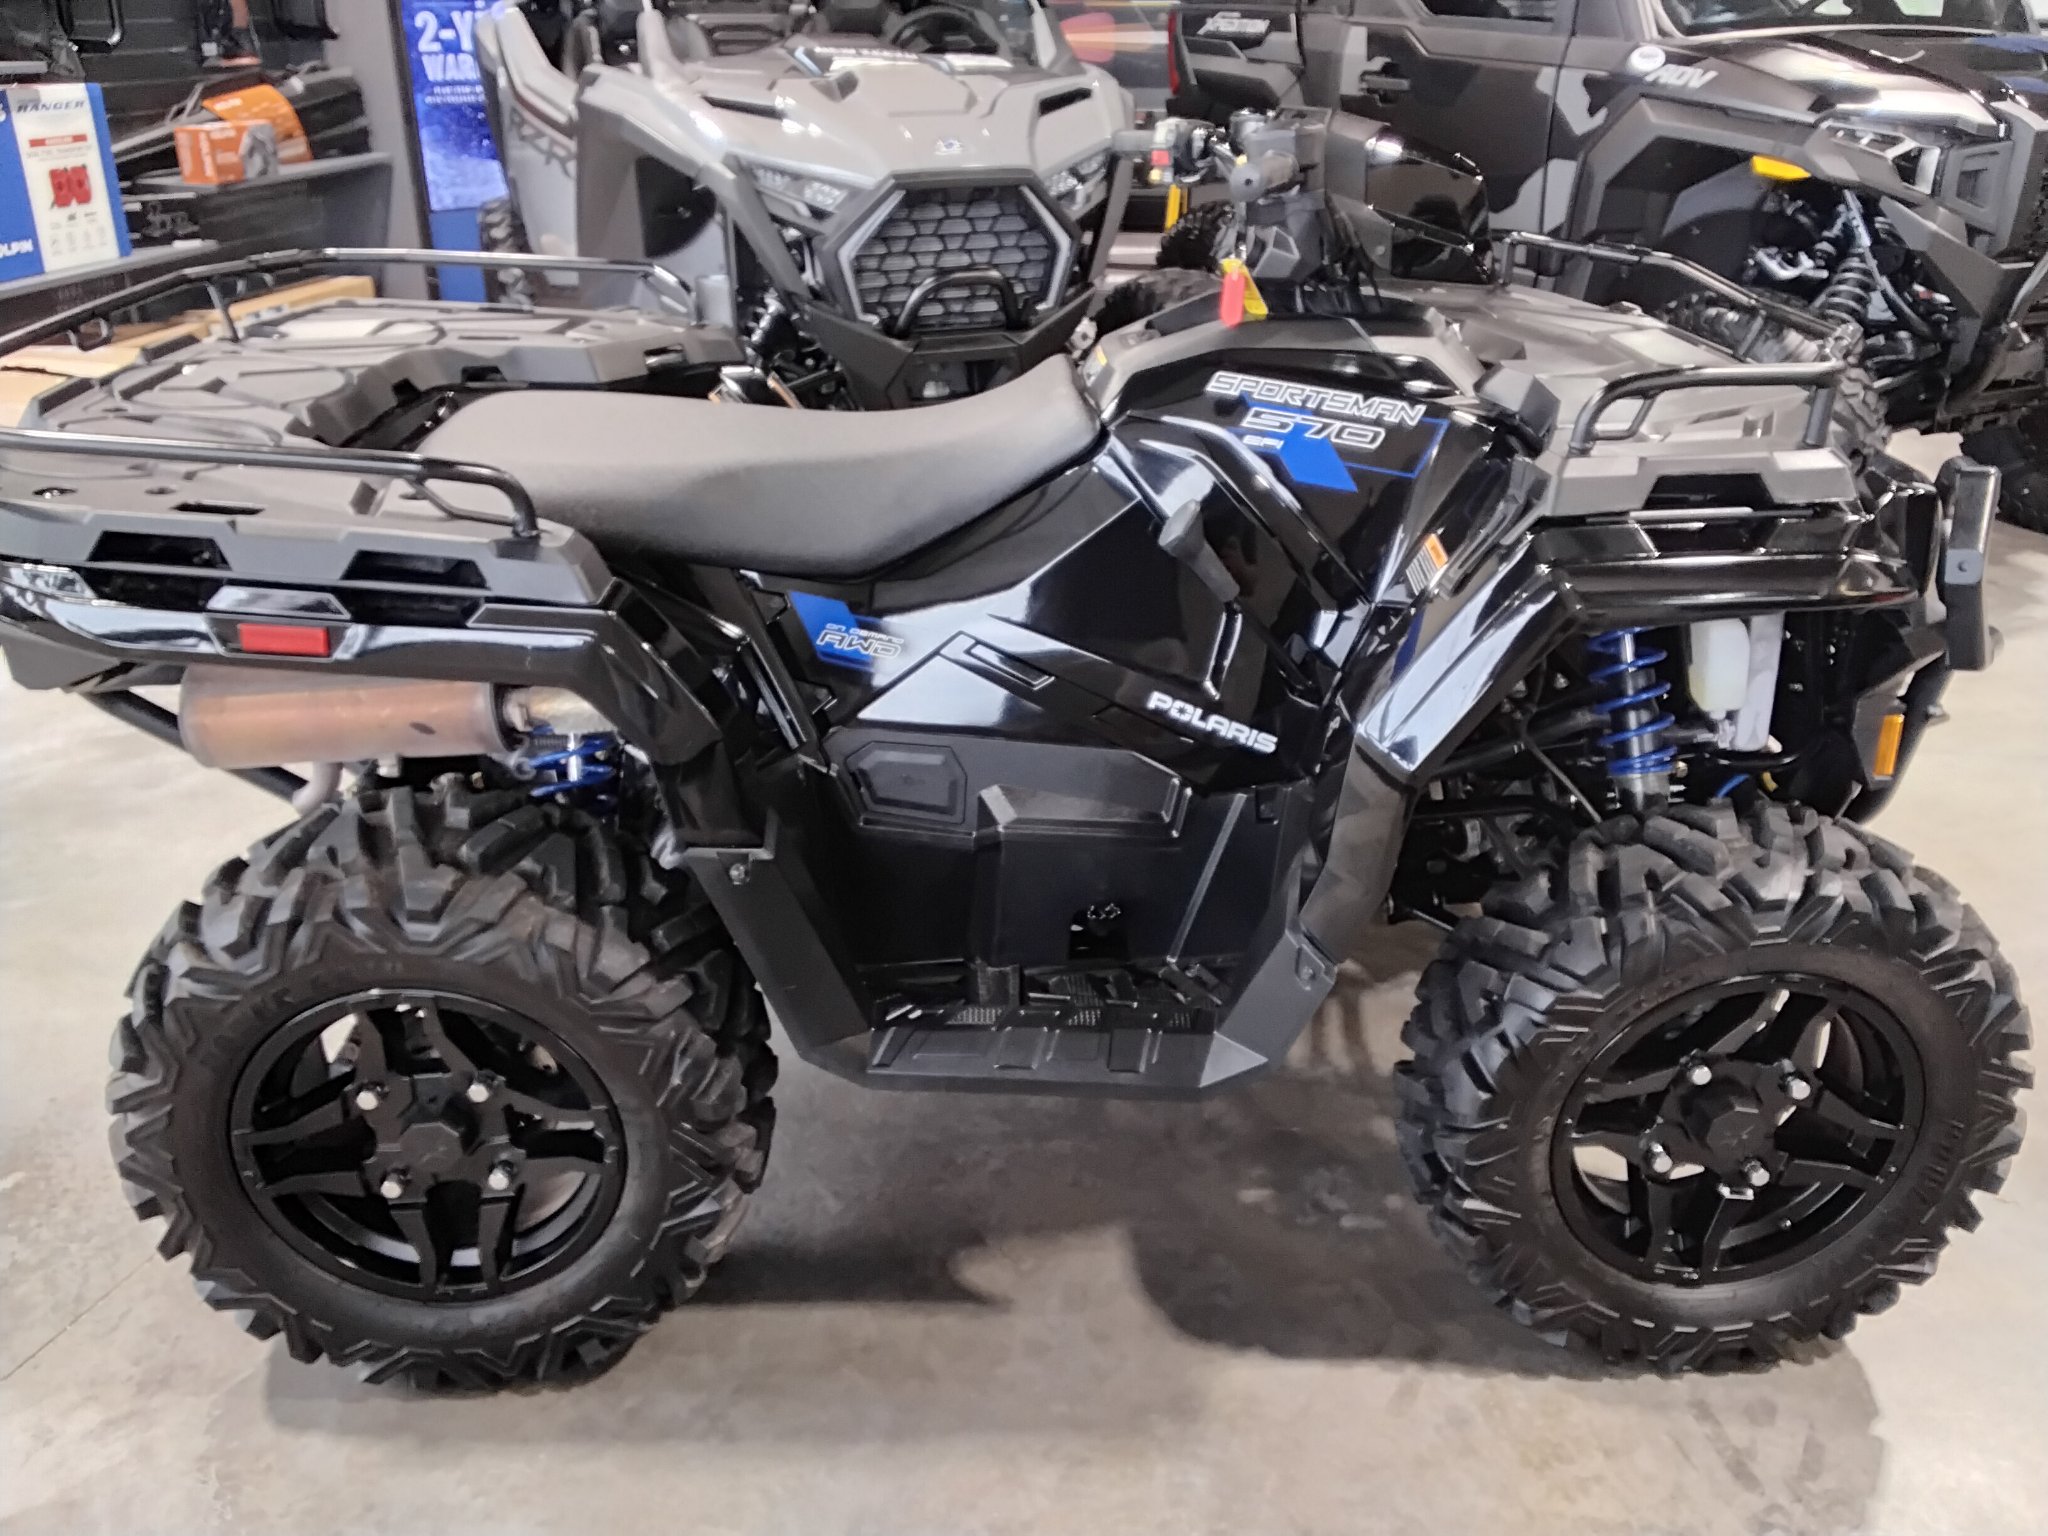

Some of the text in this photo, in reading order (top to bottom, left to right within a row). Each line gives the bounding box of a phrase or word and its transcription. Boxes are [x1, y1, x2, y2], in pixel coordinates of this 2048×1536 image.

[421, 53, 481, 82] WAR
[1645, 63, 1719, 89] ADV
[16, 100, 85, 113] RANGER
[1205, 371, 1426, 426] SPORTSMAN
[1240, 407, 1386, 450] 570
[816, 629, 901, 659] AWD
[1146, 690, 1278, 754] POLARIS
